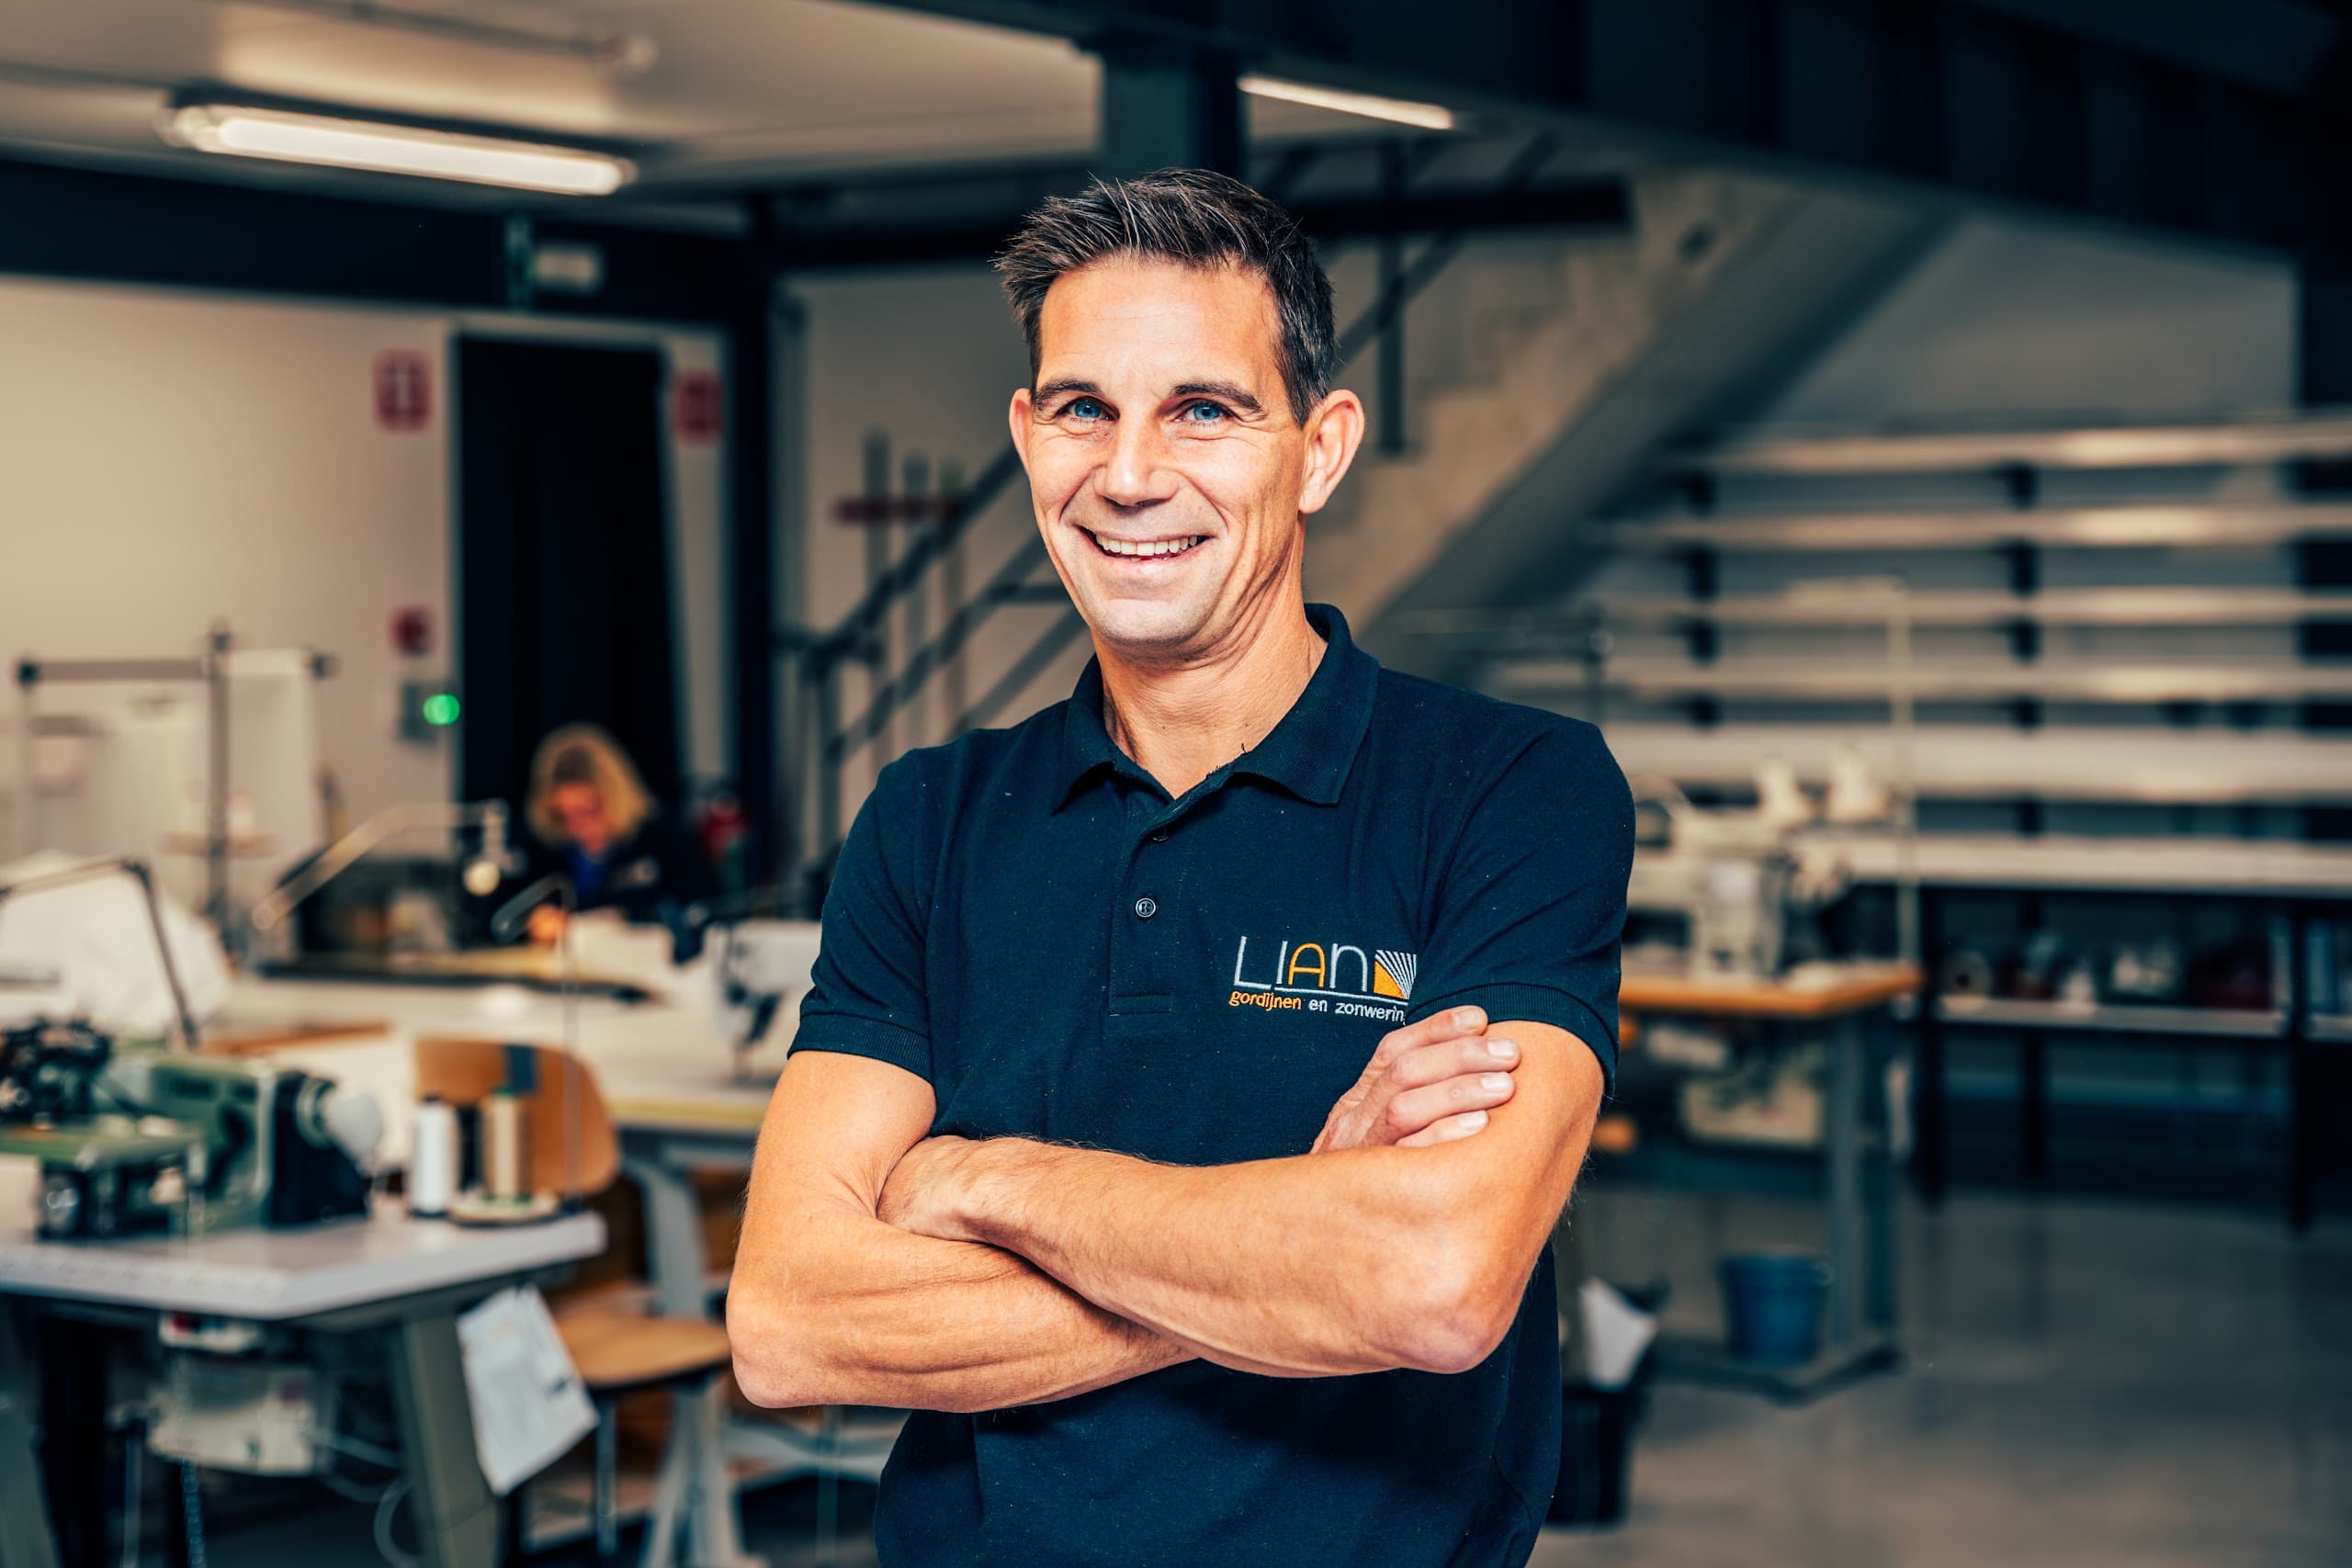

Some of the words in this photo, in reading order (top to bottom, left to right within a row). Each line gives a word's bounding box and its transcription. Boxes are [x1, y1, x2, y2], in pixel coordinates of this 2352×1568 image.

[1228, 991, 1302, 1011] gordijnen
[1308, 998, 1328, 1012] en
[1335, 1002, 1406, 1025] zonwerin
